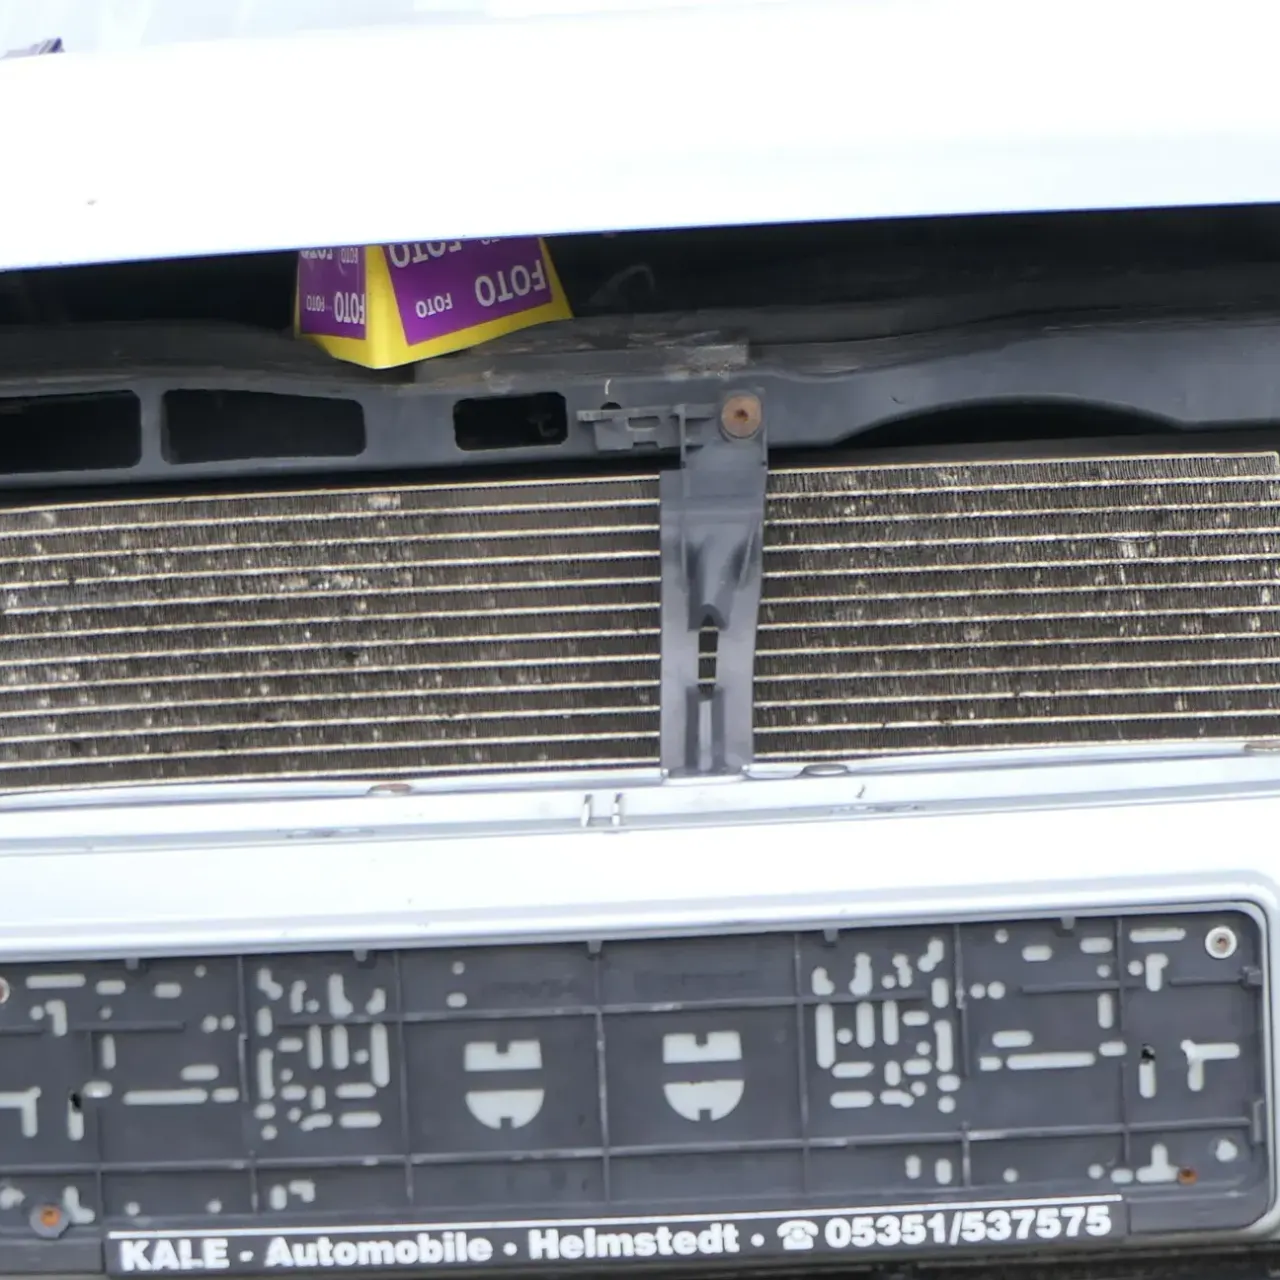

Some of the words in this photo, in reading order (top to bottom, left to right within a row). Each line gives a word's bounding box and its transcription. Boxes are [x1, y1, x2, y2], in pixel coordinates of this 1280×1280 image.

[474, 259, 546, 307] FOTO
[306, 295, 325, 312] FOTO
[334, 291, 365, 325] FOTO
[415, 292, 453, 318] FOTO
[120, 1238, 230, 1272] KALE
[265, 1231, 493, 1267] Automobile
[528, 1222, 740, 1261] Helmstedt
[824, 1205, 1113, 1250] 05351/537575
